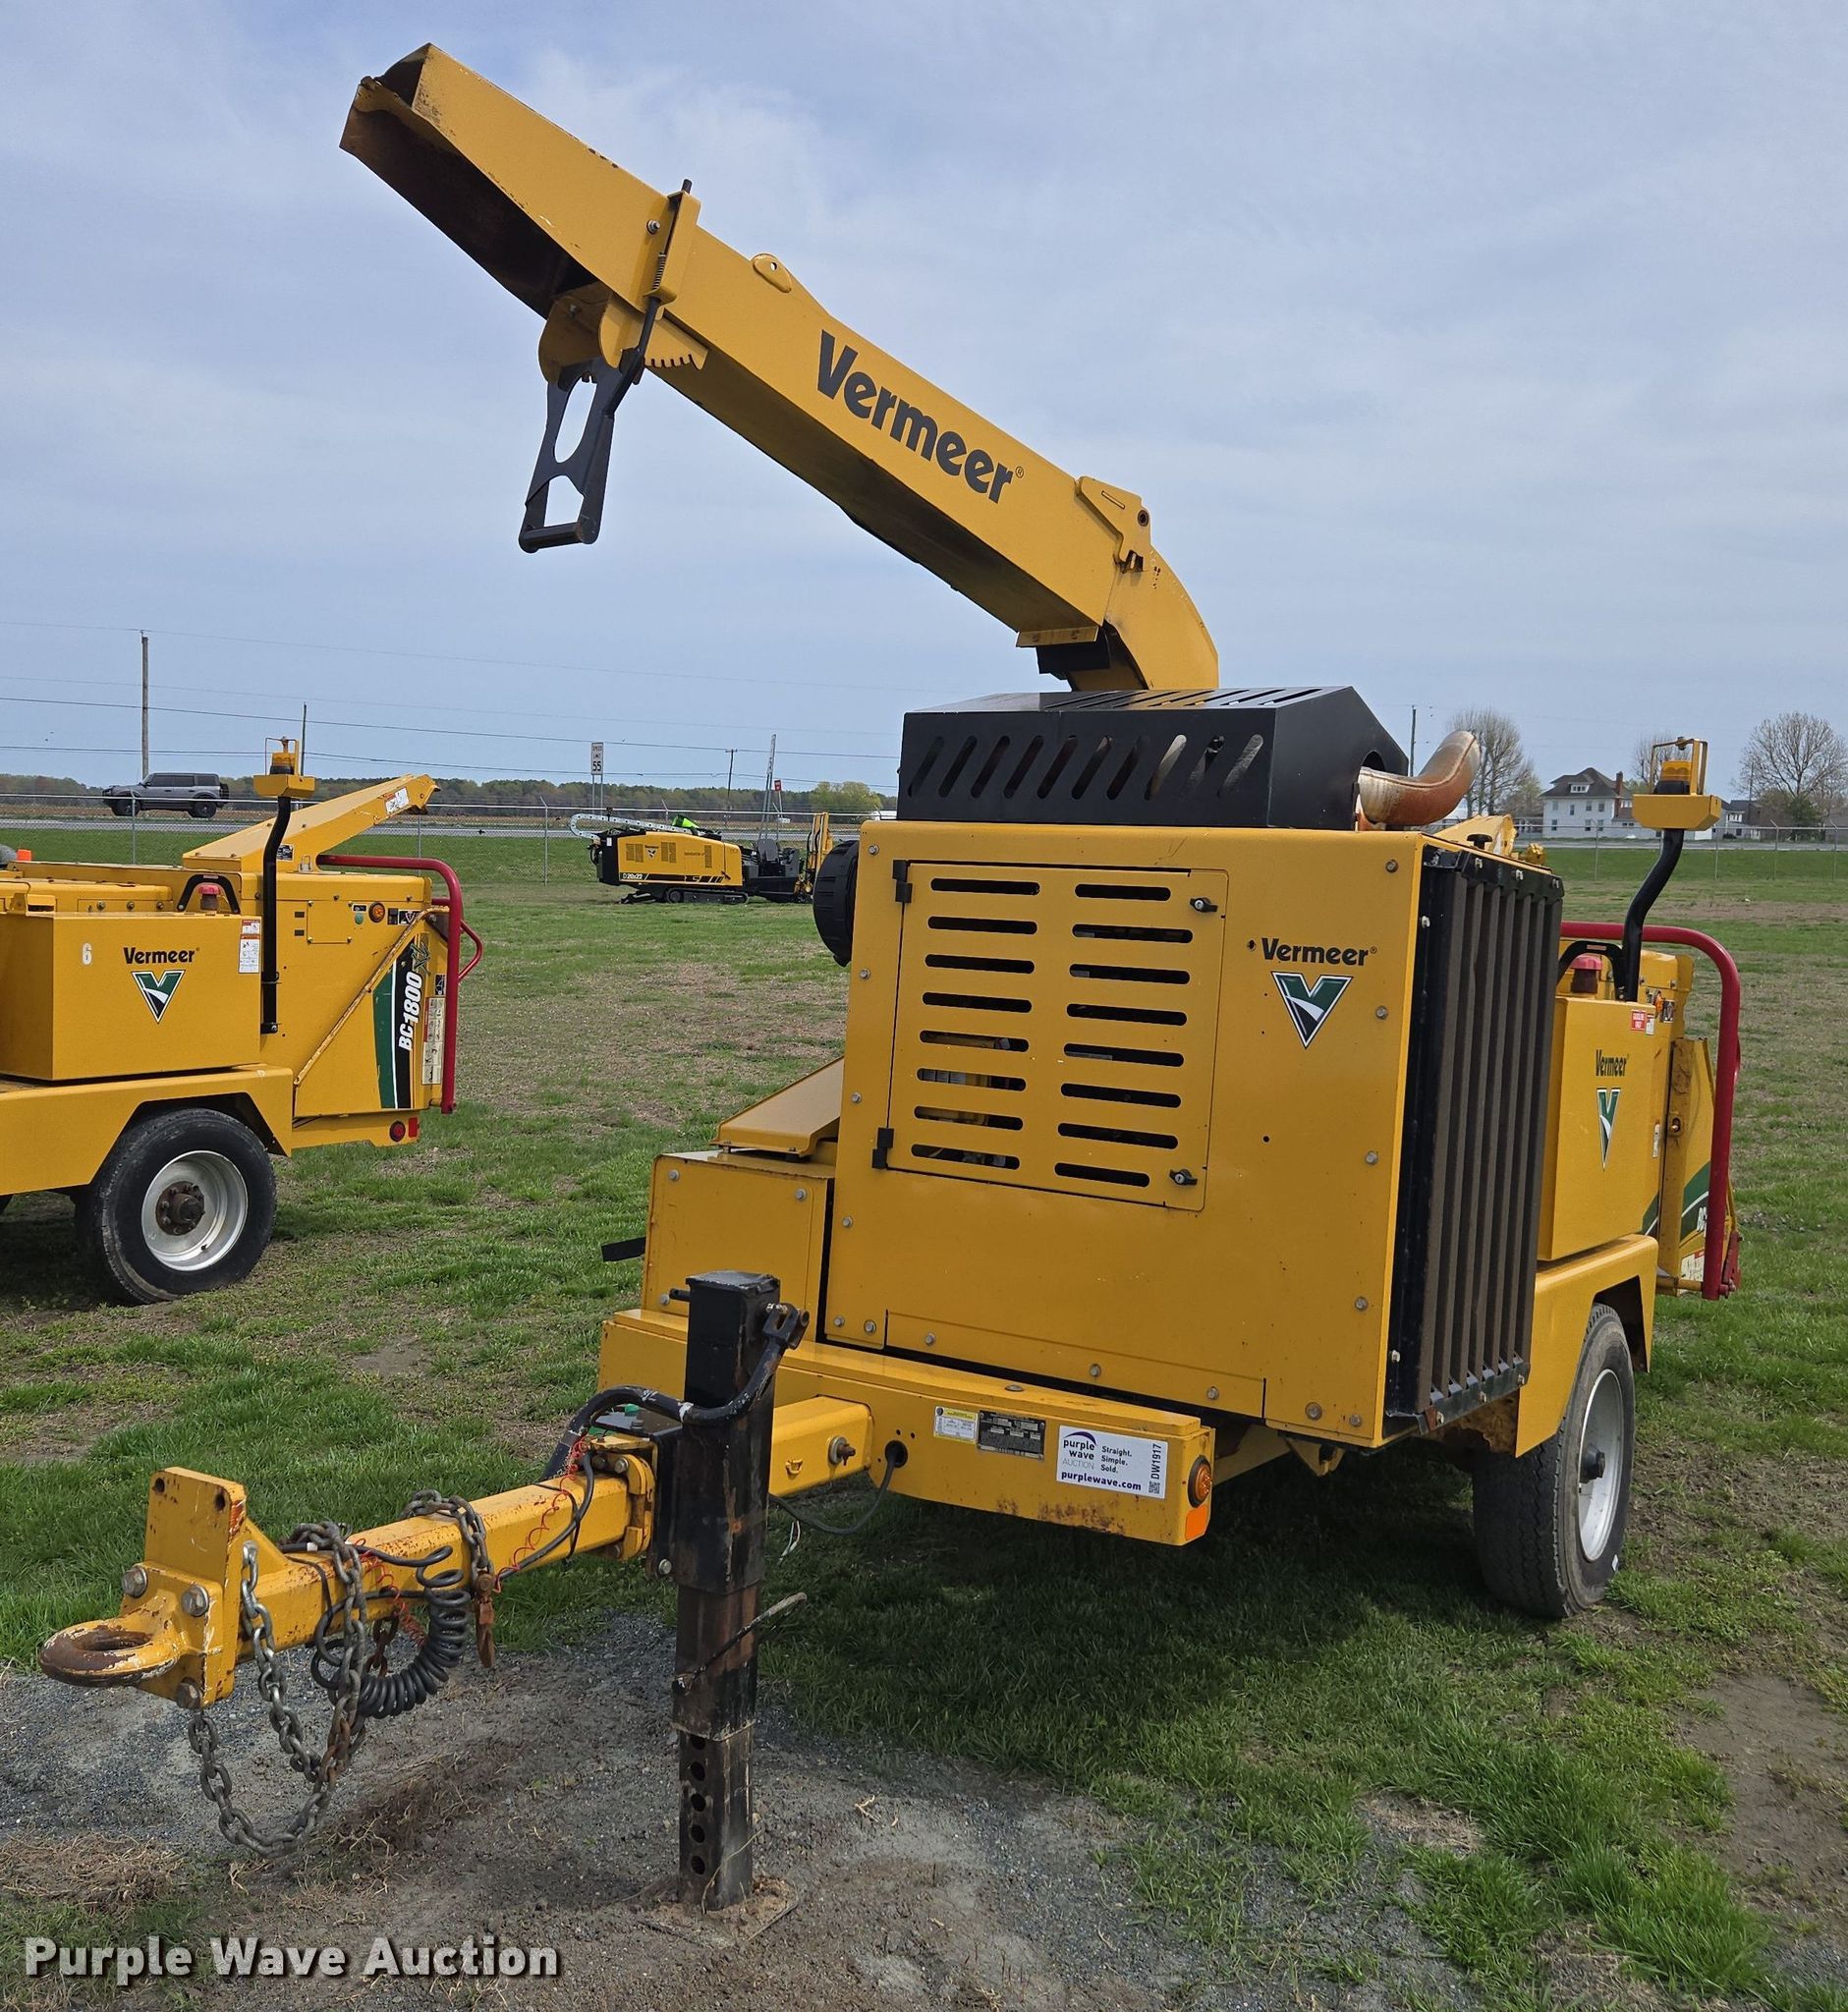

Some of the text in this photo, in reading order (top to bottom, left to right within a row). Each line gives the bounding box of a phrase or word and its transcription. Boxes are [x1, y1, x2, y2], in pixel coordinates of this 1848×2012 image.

[817, 329, 1014, 504] Vermeer
[592, 760, 601, 771] 55
[82, 942, 92, 966] 6
[123, 947, 195, 964] Vermeer
[1261, 937, 1369, 966] Vermeer
[1596, 1049, 1627, 1077] Vermeer
[1063, 1439, 1095, 1450] purple
[1101, 1445, 1133, 1457] Straight.
[1069, 1449, 1094, 1460] wave
[1101, 1455, 1128, 1466] Simple.
[1150, 1443, 1161, 1480] DW1917
[1062, 1458, 1094, 1470] AUCTION
[1100, 1464, 1118, 1474] Sold.
[1061, 1471, 1142, 1490] purplewave.com
